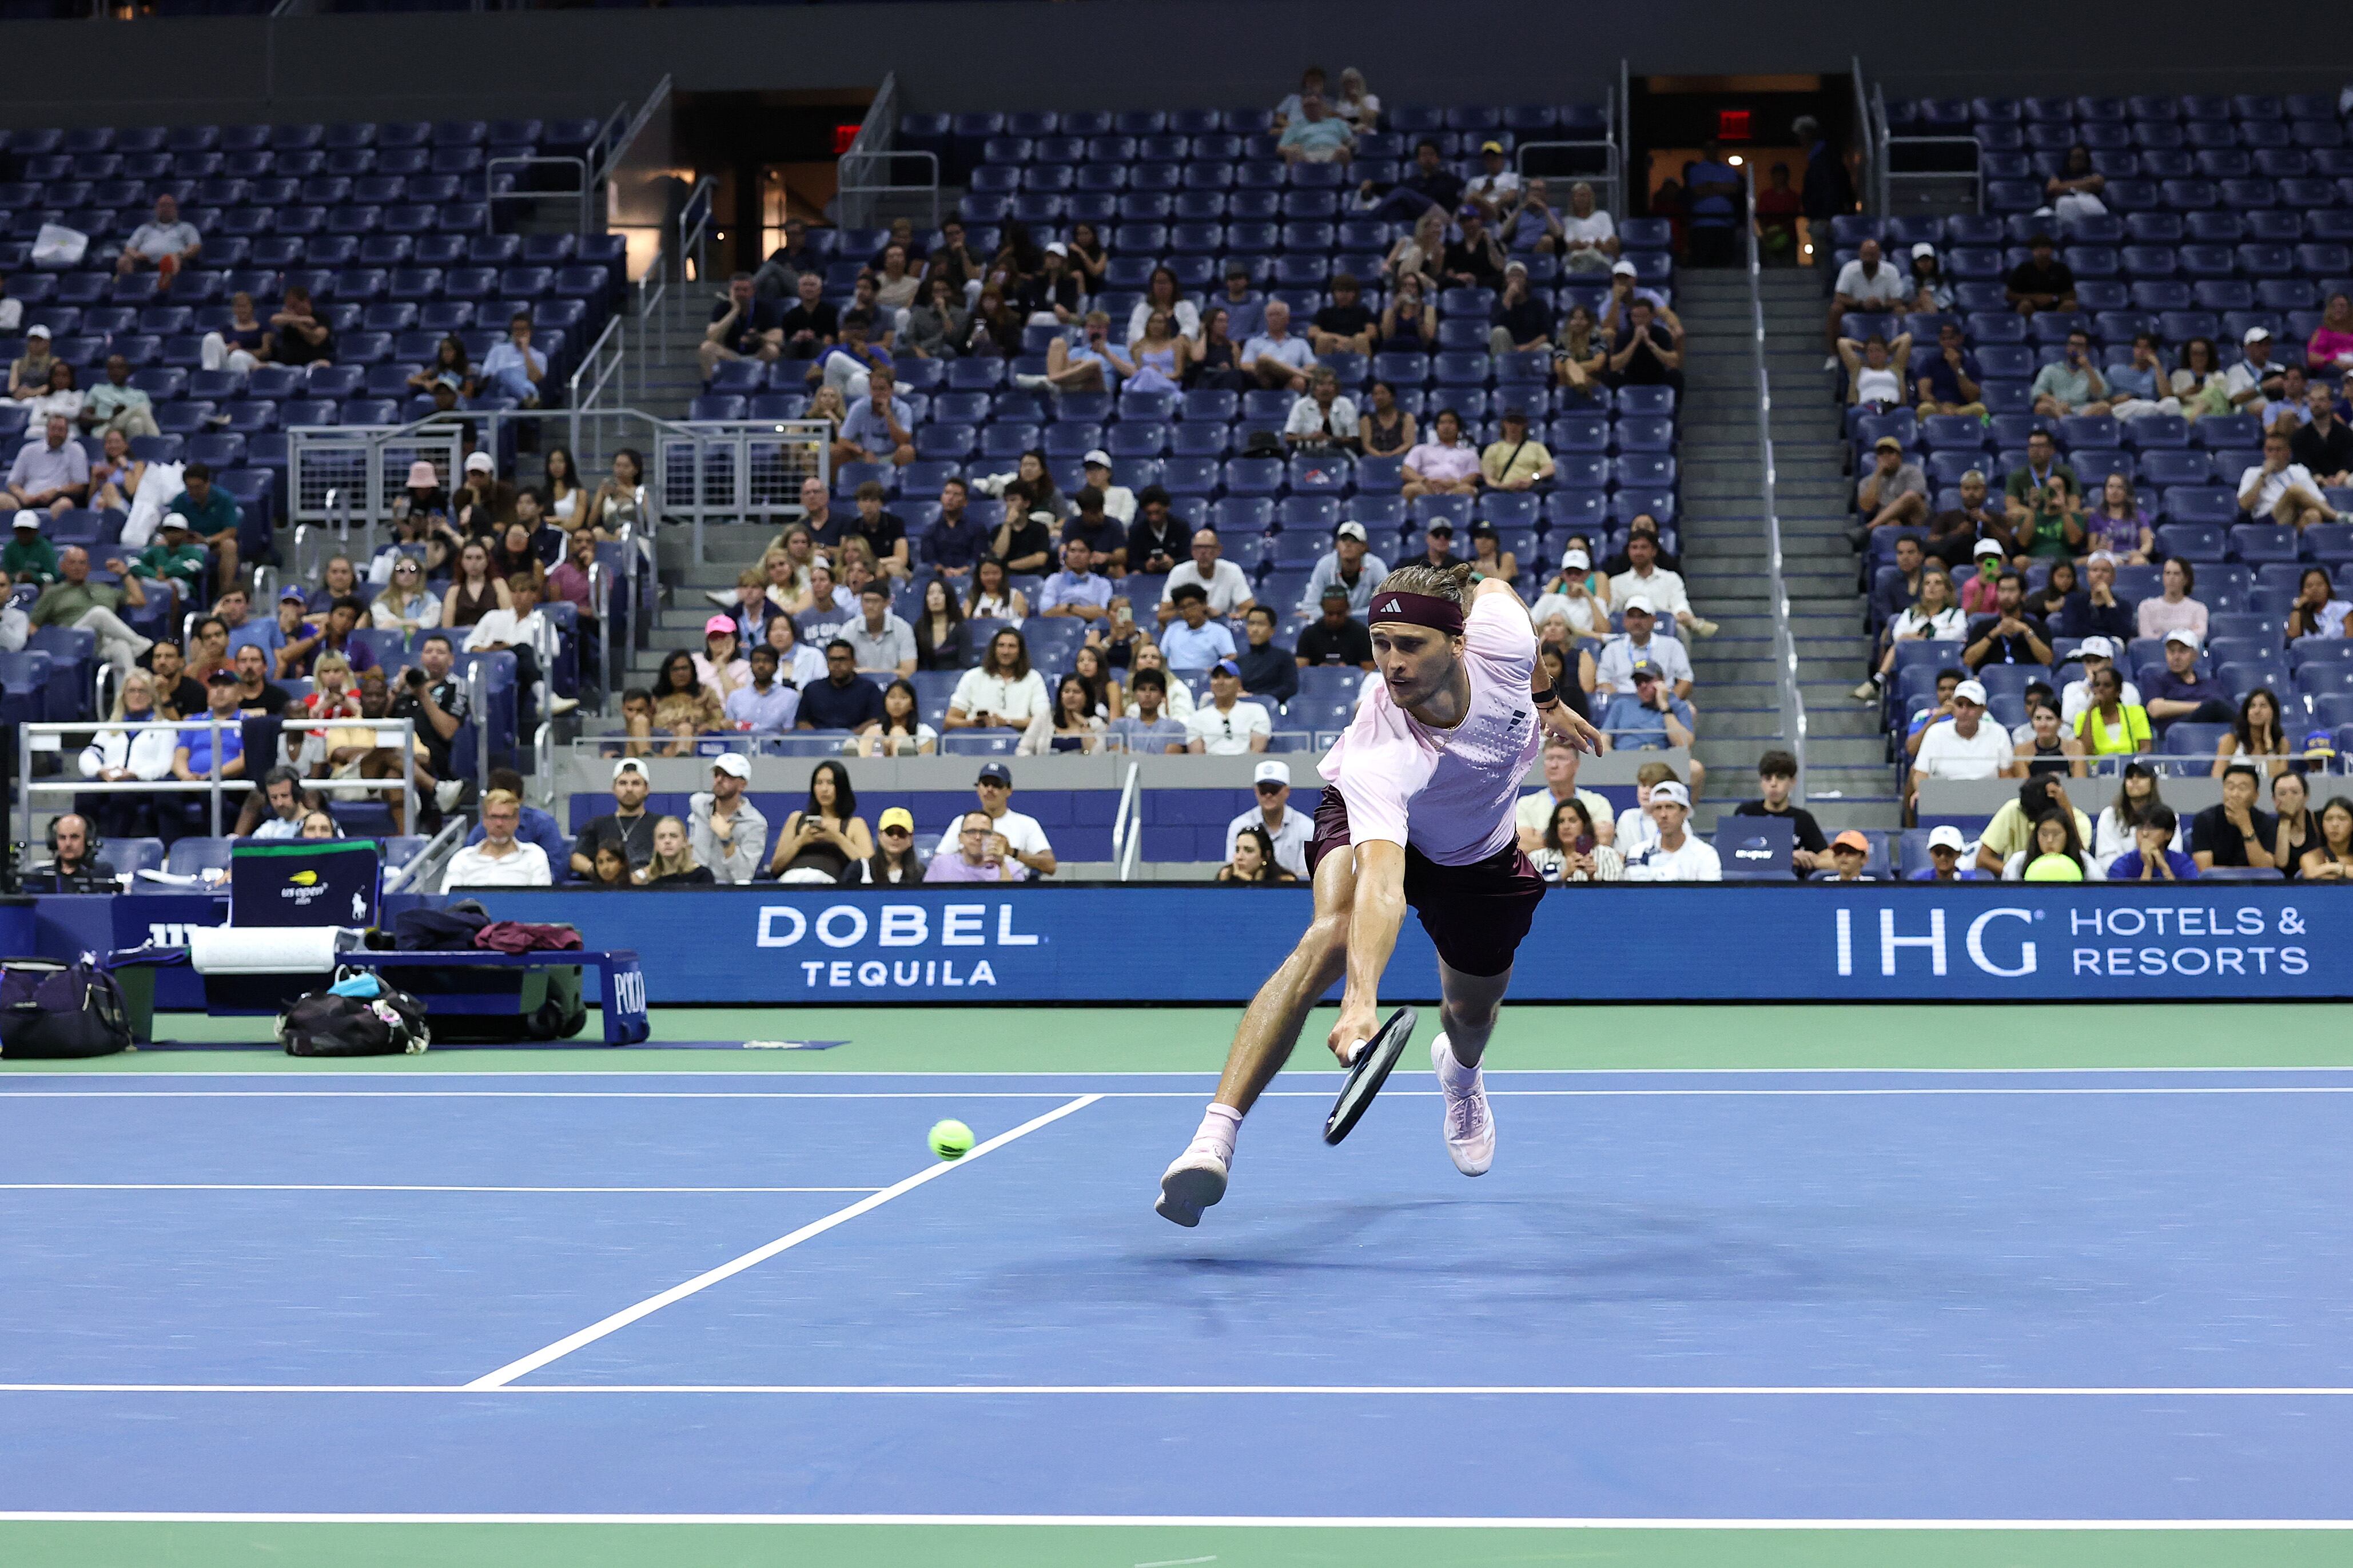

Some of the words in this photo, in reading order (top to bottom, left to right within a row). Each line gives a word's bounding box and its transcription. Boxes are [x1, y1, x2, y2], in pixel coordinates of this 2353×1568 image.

[755, 904, 1039, 948] DOBEL
[2070, 907, 2267, 936] HOTELS
[2278, 906, 2307, 935] &
[1836, 907, 2039, 977] IHG
[801, 960, 997, 988] TEQUILA
[2072, 946, 2310, 977] RESORTS
[613, 970, 646, 1016] POLO
